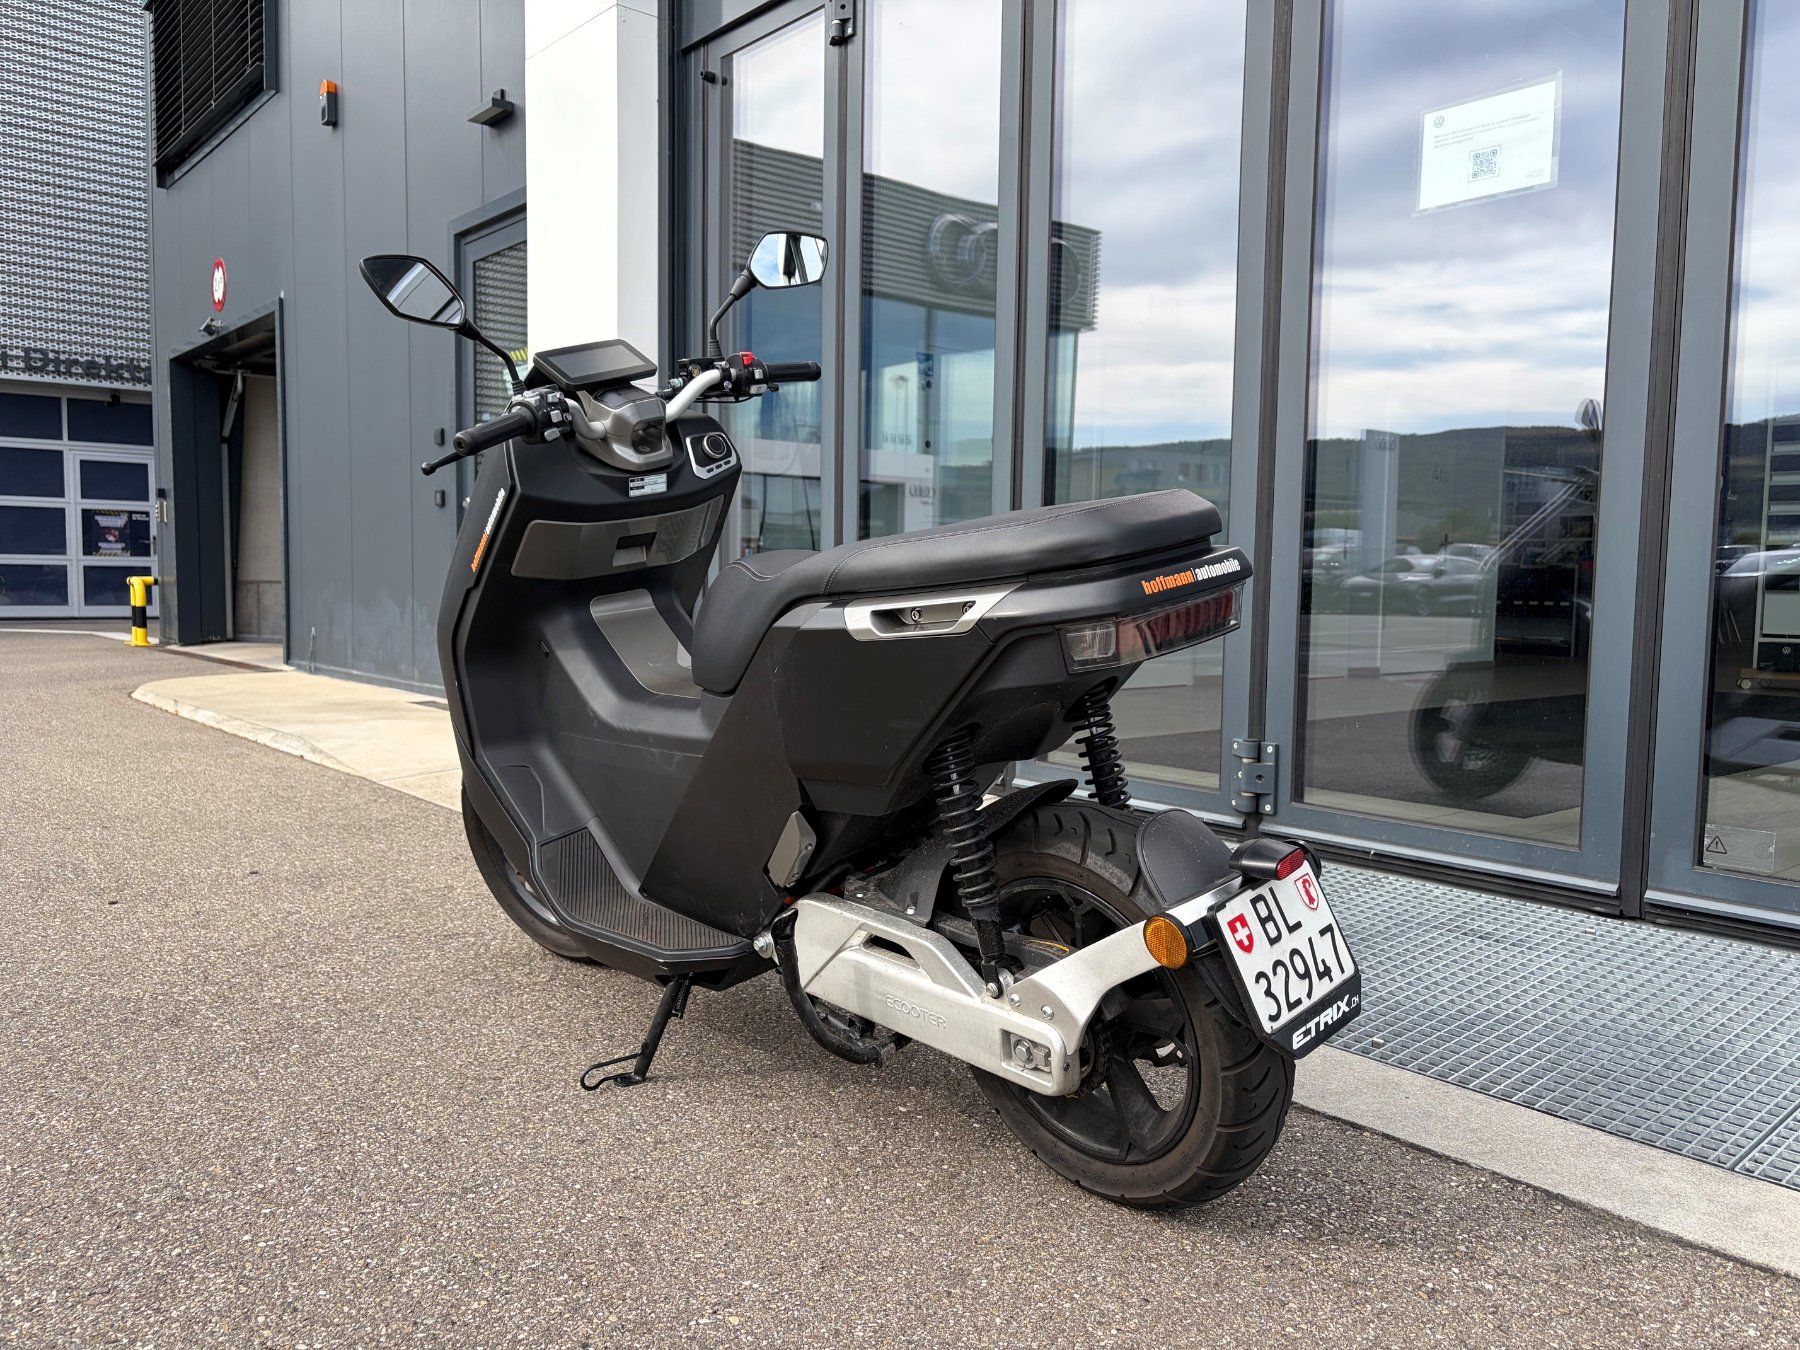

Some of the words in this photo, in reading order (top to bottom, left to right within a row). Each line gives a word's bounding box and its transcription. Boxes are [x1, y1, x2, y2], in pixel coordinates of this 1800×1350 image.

[1141, 571, 1195, 595] hoffmann
[1195, 558, 1240, 580] automobile
[1250, 887, 1302, 946] BL
[1255, 923, 1345, 1022] 32947
[884, 994, 947, 1029] ECOOTER
